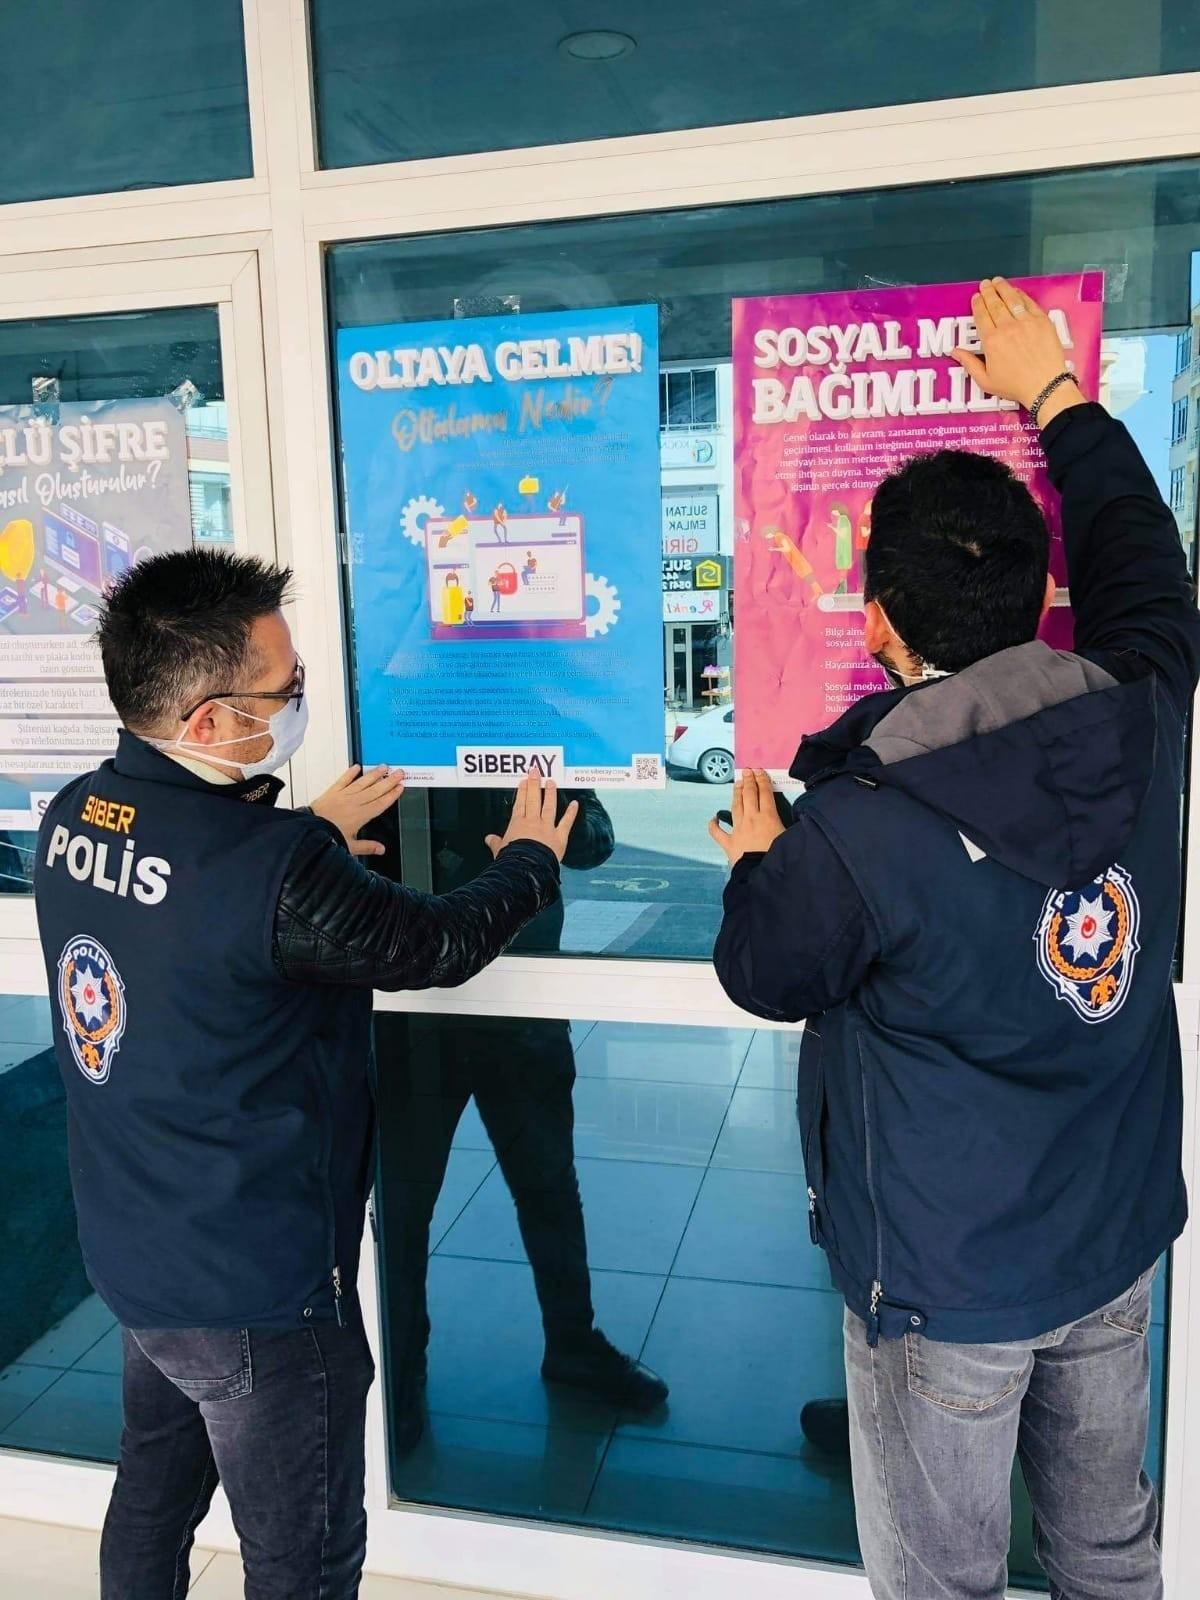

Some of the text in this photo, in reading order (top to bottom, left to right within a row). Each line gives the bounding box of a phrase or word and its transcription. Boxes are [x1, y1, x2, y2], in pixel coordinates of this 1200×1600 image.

[753, 320, 912, 369] SOSYAL
[349, 332, 643, 391] OLTAYA GELME!
[809, 431, 836, 440] olarak
[838, 430, 849, 440] bu
[888, 428, 926, 437] zamanın
[928, 426, 967, 438] çoğunun
[969, 422, 997, 434] sosyal
[0, 415, 169, 472] LÜ ŞİFRE
[834, 442, 873, 452] kullanım
[875, 440, 913, 452] isteğinin
[915, 439, 944, 448] önüne
[944, 435, 1009, 449] geçilememesi,
[1021, 446, 1045, 458] takip
[779, 458, 816, 469] medyayı
[818, 456, 850, 467] hayatın
[851, 453, 898, 464] merkezine
[35, 460, 162, 506] Oluşturulur?
[799, 469, 830, 481] ihtiyacı
[791, 481, 820, 492] kişinin
[821, 480, 850, 491] gerçek
[825, 628, 845, 638] Bilgi
[825, 640, 852, 648] sosyal
[825, 660, 869, 671] Hayatınıza
[825, 682, 852, 692] Sosyal
[854, 681, 882, 692] medya
[46, 824, 171, 905] POLİS
